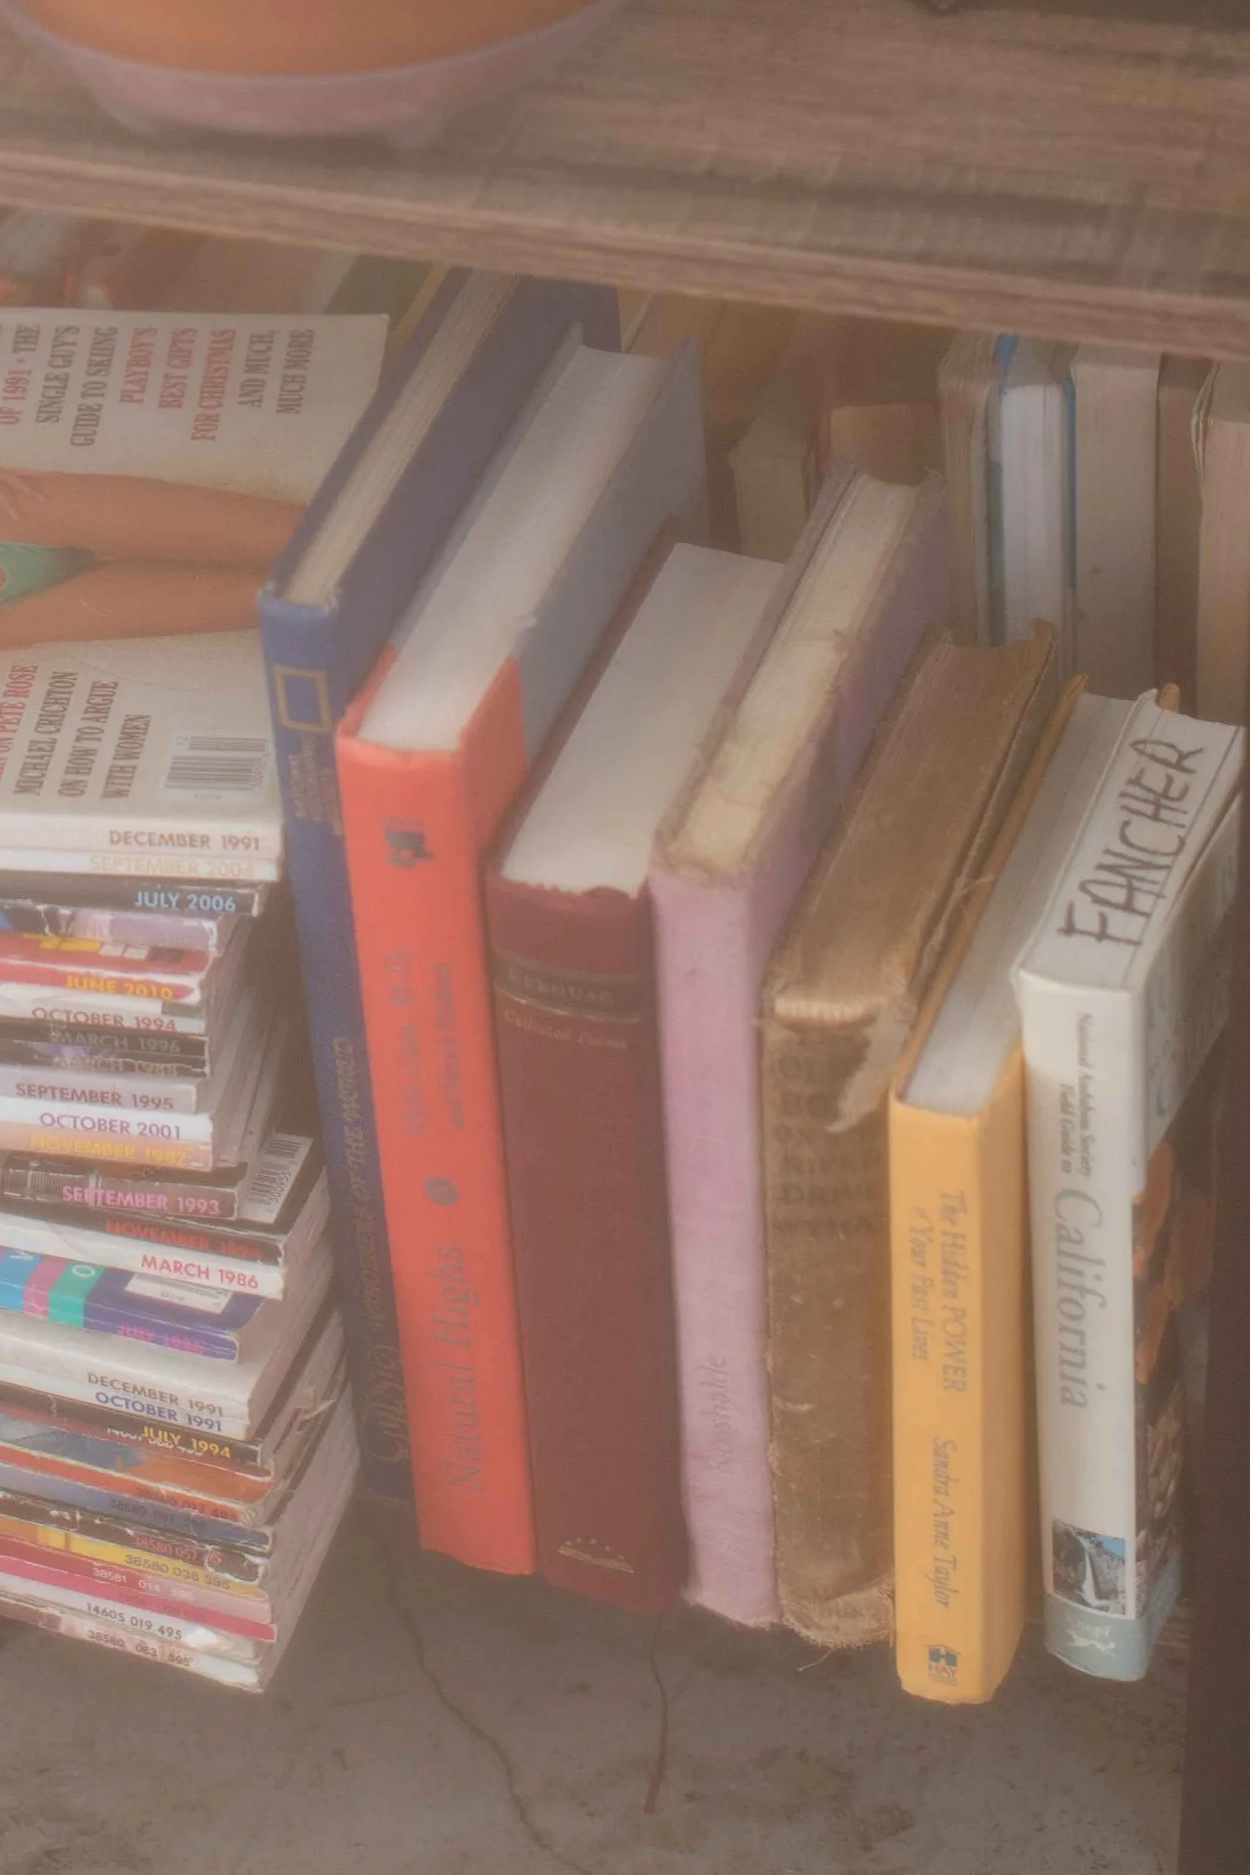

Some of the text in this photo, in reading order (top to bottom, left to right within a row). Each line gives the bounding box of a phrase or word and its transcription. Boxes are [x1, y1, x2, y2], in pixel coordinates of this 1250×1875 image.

[12, 324, 41, 354] THE
[158, 327, 198, 409] BEST GIFTS
[238, 330, 279, 408] AND MUCH,
[276, 328, 315, 414] MUCH MORE
[2, 368, 32, 403] 1991
[35, 371, 70, 424] SINGLE
[70, 326, 118, 447] GUIDE TO SKIING
[191, 328, 236, 442] FOR CHRISTMAS
[2, 665, 38, 698] ROSE
[13, 671, 78, 796] MICHAEL CRICHTON
[58, 681, 119, 797] ON HOW TO ARGUE
[102, 714, 151, 798] WITH WOMEN
[109, 829, 259, 851] DECEMBER 1991
[1058, 738, 1203, 946] FANCHER
[134, 891, 236, 911] JULY 2006
[16, 1083, 174, 1110] SEPTEMBER 1995
[940, 1189, 968, 1227] The
[1054, 1188, 1107, 1409] California
[427, 1242, 484, 1494] Natural Highs
[942, 1303, 968, 1393] POWER
[95, 1391, 222, 1432] OCTOBER 1991
[142, 1425, 182, 1446] JULY
[190, 1437, 231, 1459] 1994
[925, 1436, 960, 1610] Sandra Anne Taylor
